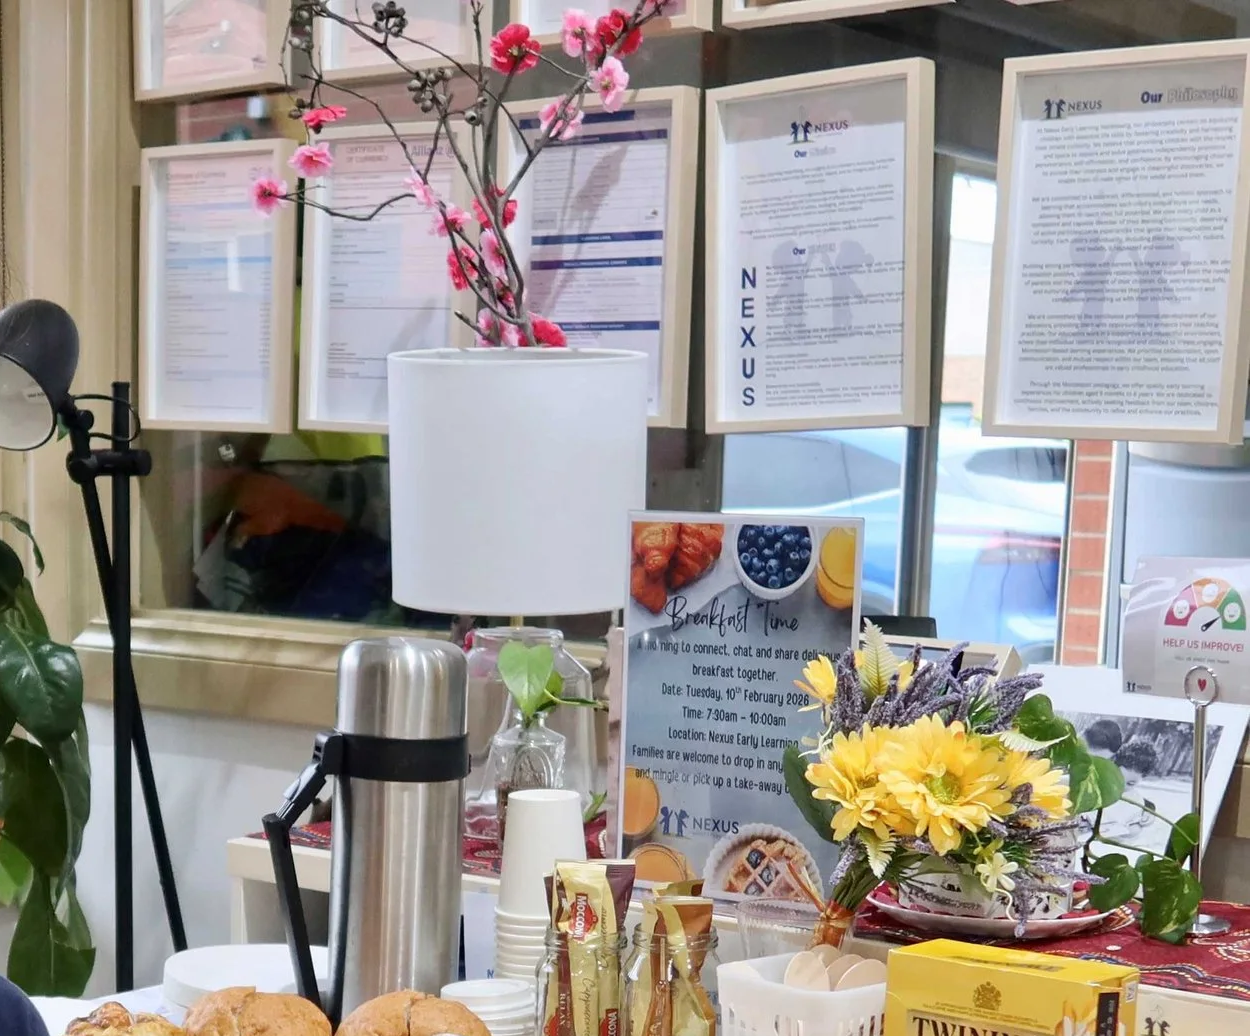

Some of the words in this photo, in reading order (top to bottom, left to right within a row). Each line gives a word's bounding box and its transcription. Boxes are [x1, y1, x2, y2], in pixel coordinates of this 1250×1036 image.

[1068, 100, 1102, 111] NEXUS
[1140, 91, 1163, 104] Our
[814, 120, 849, 133] NEXUS
[665, 595, 750, 637] Breakfast
[757, 599, 800, 636] Time
[645, 640, 679, 655] moning
[681, 639, 691, 653] to
[733, 644, 753, 657] chat
[756, 644, 773, 659] and
[775, 646, 800, 661] share
[1163, 637, 1185, 648] HELP
[1187, 640, 1199, 649] US
[1201, 640, 1245, 652] IMPROVE!
[693, 663, 734, 679] breakfast
[737, 667, 779, 683] together.
[661, 683, 684, 697] Date:
[744, 689, 784, 707] February
[786, 693, 810, 707] 2026
[682, 706, 704, 720] Time:
[706, 708, 738, 722] 7:30am
[749, 713, 787, 727] 10:00am
[668, 727, 707, 741] Location:
[708, 730, 735, 744] Nexus
[736, 733, 759, 749] Early
[632, 744, 664, 759] Families
[666, 749, 681, 761] are
[682, 749, 719, 764] welcome
[721, 753, 732, 766] to
[734, 754, 754, 770] drop
[756, 756, 765, 769] in
[634, 767, 650, 780] and
[652, 768, 679, 785] mingle
[681, 774, 690, 783] or
[693, 772, 711, 786] pick
[712, 776, 724, 789] up
[726, 778, 732, 788] a
[734, 775, 783, 796] take-away
[692, 817, 740, 835] NEXUS
[573, 895, 587, 942] MOCCON
